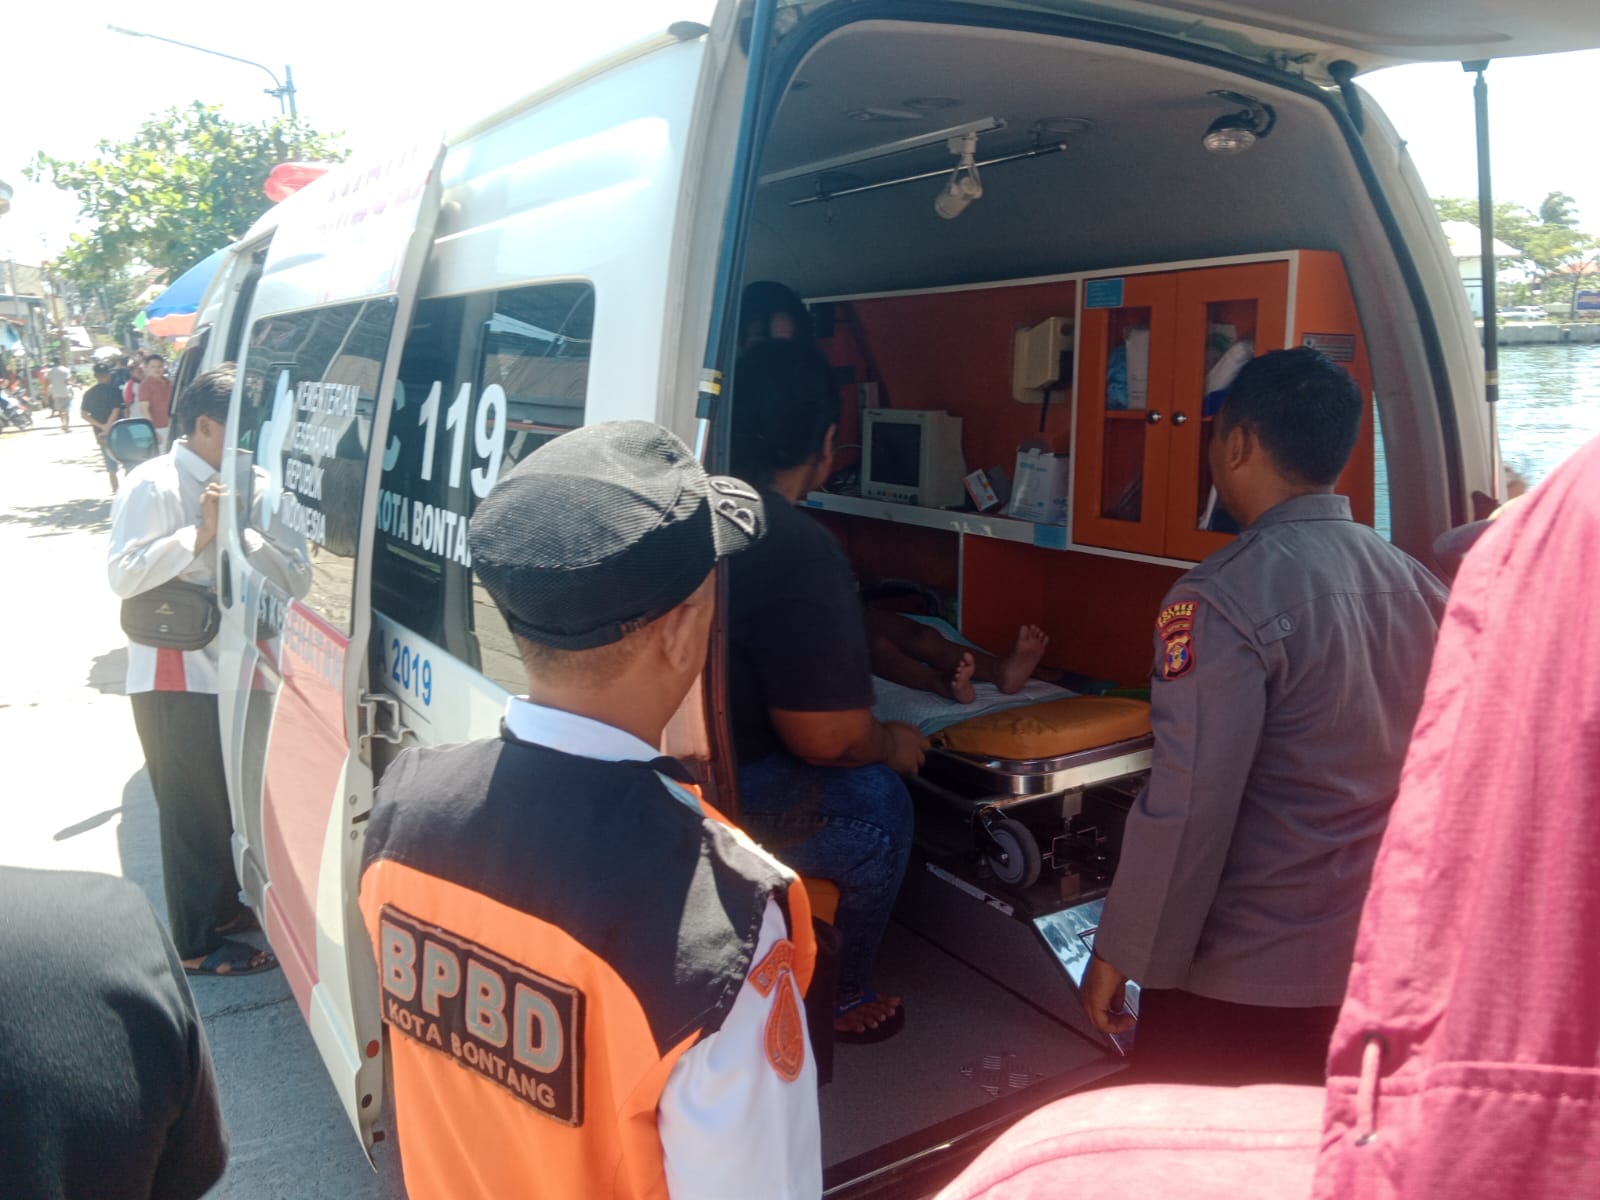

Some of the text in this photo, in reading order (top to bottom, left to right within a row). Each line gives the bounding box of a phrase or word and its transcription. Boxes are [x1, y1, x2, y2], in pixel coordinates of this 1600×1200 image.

[418, 380, 507, 498] 119
[411, 500, 472, 569] BONTA
[392, 638, 433, 707] 2019
[381, 919, 565, 1075] BPBD
[387, 998, 556, 1109] KOTA BONTANG
